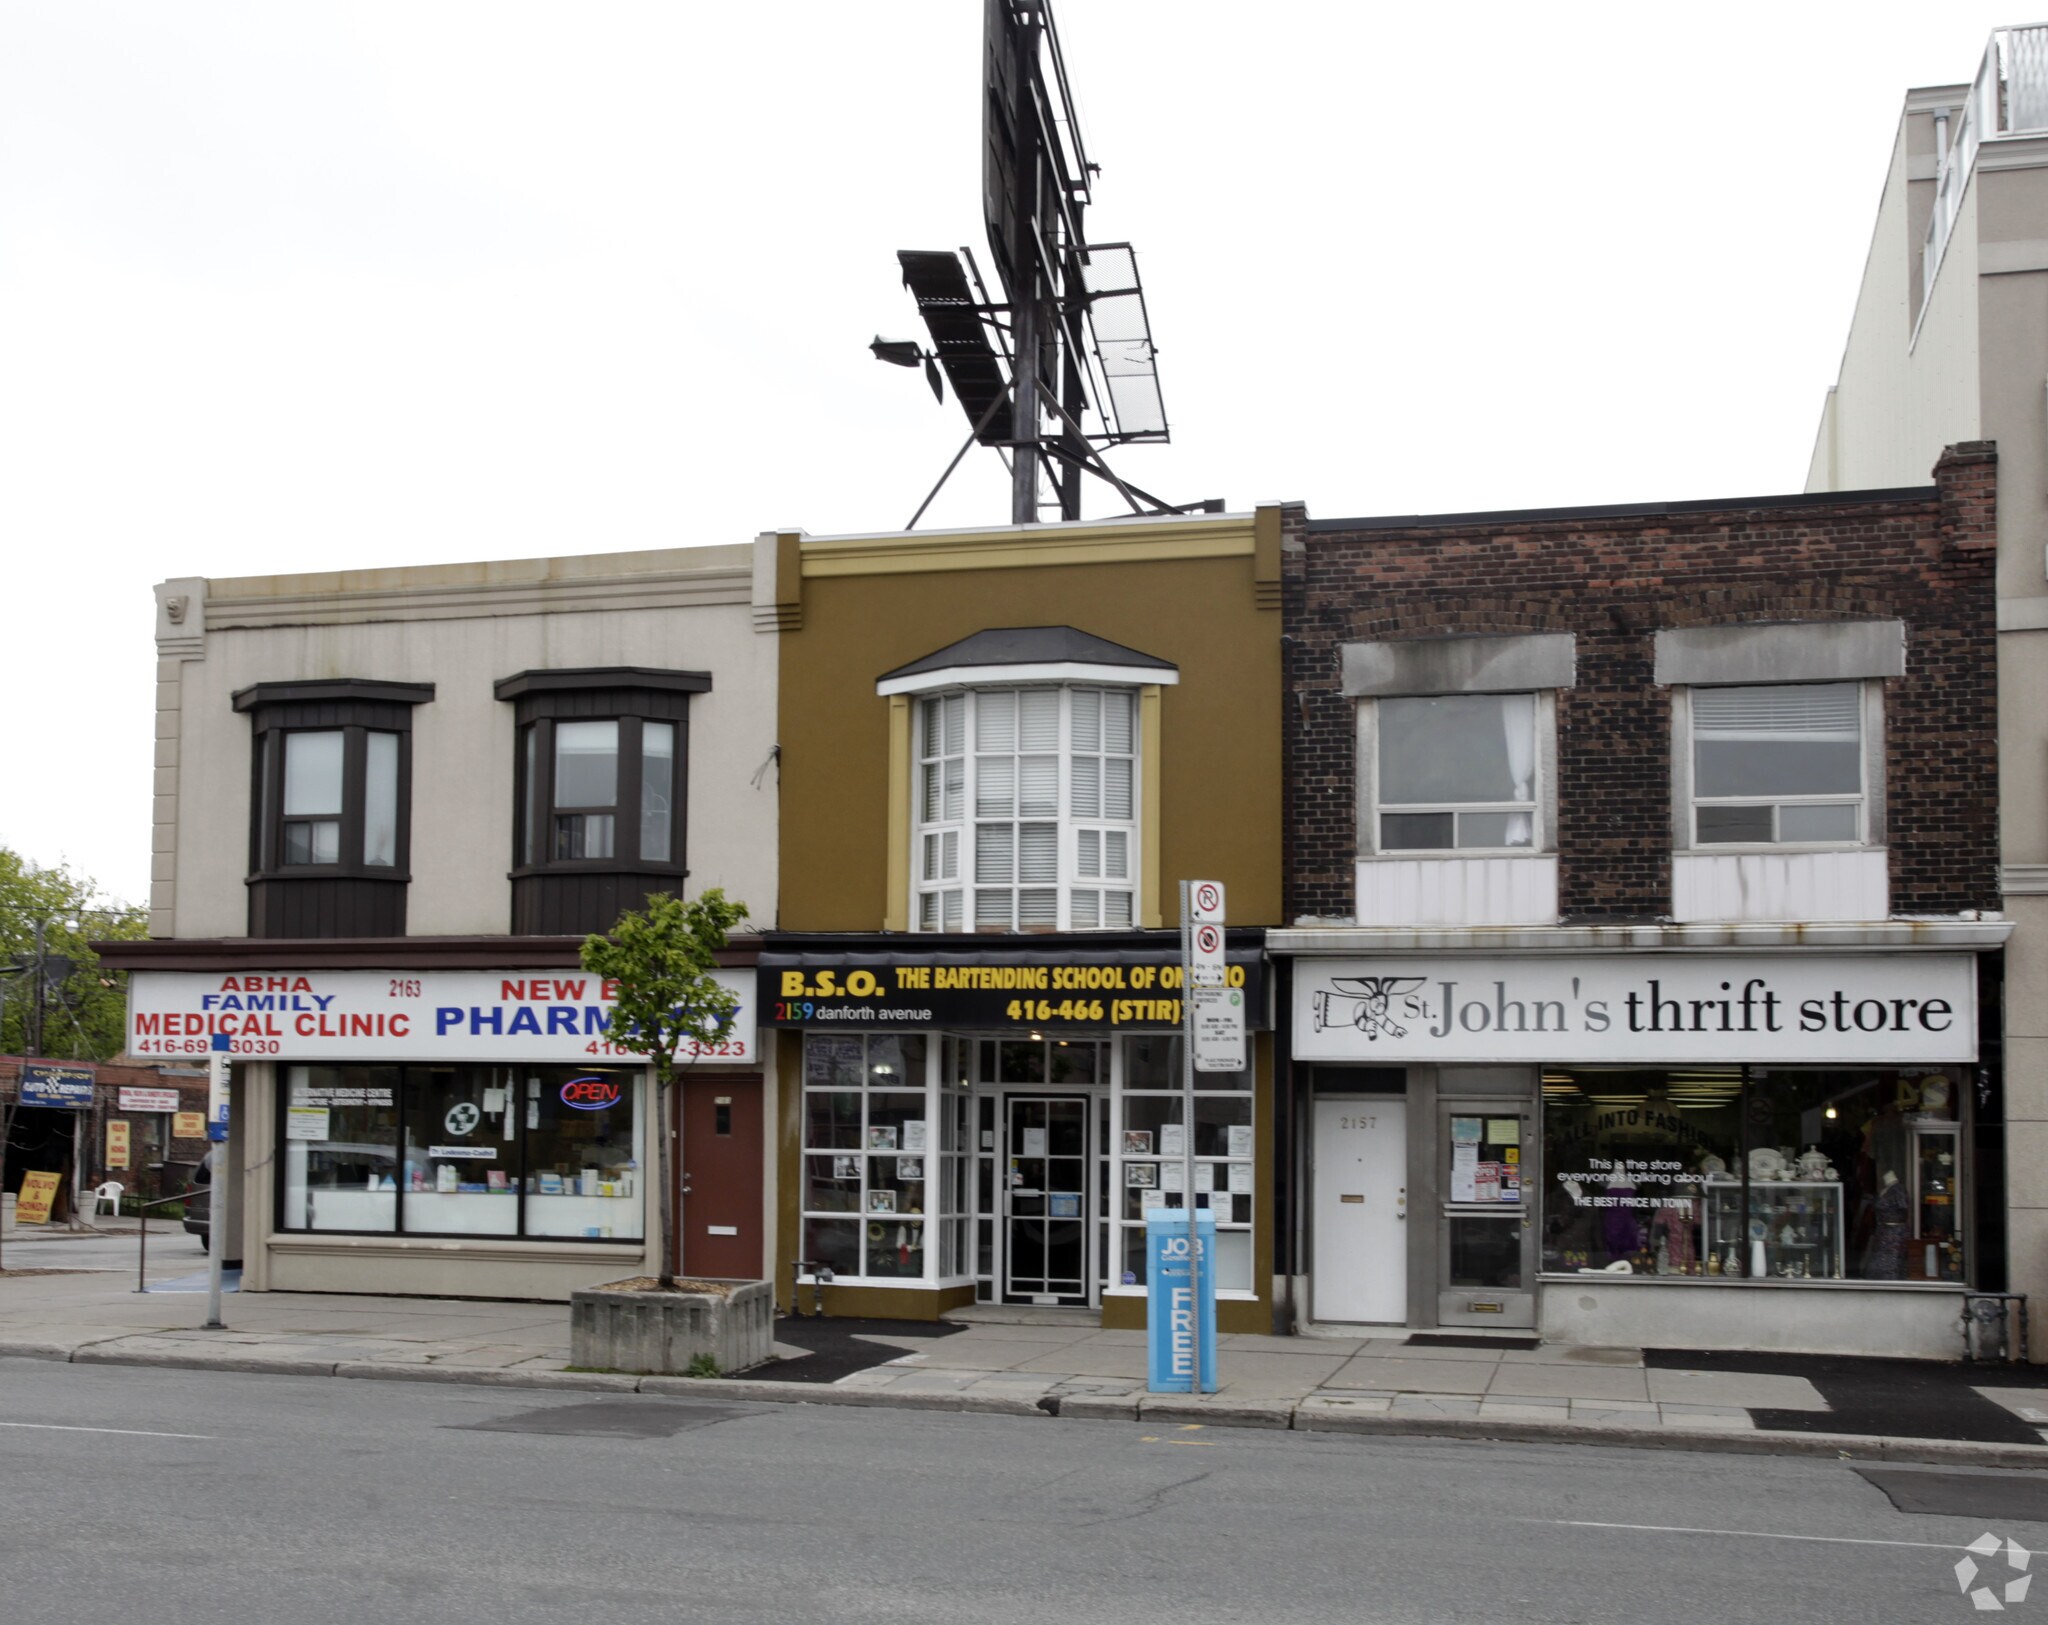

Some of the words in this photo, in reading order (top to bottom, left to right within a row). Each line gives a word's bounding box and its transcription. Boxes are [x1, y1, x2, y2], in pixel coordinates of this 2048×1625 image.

[220, 976, 313, 993] ABHA
[389, 979, 421, 998] 2163
[501, 979, 587, 1001] NEW
[780, 970, 885, 997] B.S.O.
[895, 967, 930, 989] THE
[934, 967, 1048, 989] BARTENDING
[1052, 966, 1126, 990] SCHOOL
[1130, 966, 1156, 989] OF
[1160, 966, 1245, 989] ONIO
[201, 994, 336, 1011] FAMILY
[774, 1002, 814, 1020] 2159
[816, 1004, 876, 1020] danforth
[878, 1008, 932, 1020] avenue
[1006, 999, 1104, 1021] 416-466
[1111, 998, 1184, 1025] (STIR)
[1403, 995, 1437, 1020] St.
[1429, 977, 1611, 1038] John's
[1624, 978, 1783, 1032] thrift
[1800, 991, 1953, 1032] store
[135, 1013, 282, 1036] MEDICAL
[294, 1013, 411, 1037] CLINIC
[435, 1005, 744, 1036] PHARMY
[139, 1039, 281, 1054] 416-693030
[562, 1083, 619, 1101] OPEN
[1340, 1116, 1377, 1130] 2157
[1598, 1109, 1639, 1131] INTO
[1588, 1158, 1612, 1170] This
[1614, 1158, 1625, 1170] is
[1626, 1158, 1648, 1170] the
[1649, 1160, 1682, 1170] store
[1557, 1172, 1626, 1184] everyone's
[1627, 1172, 1672, 1185] talking
[1673, 1172, 1714, 1184] about
[1573, 1196, 1592, 1207] THE
[1593, 1196, 1618, 1207] BEST
[1619, 1197, 1649, 1208] PRICE
[1650, 1198, 1662, 1208] IN
[1662, 1198, 1693, 1208] TOWN
[1161, 1237, 1204, 1256] JOB
[1170, 1287, 1193, 1375] FREE
